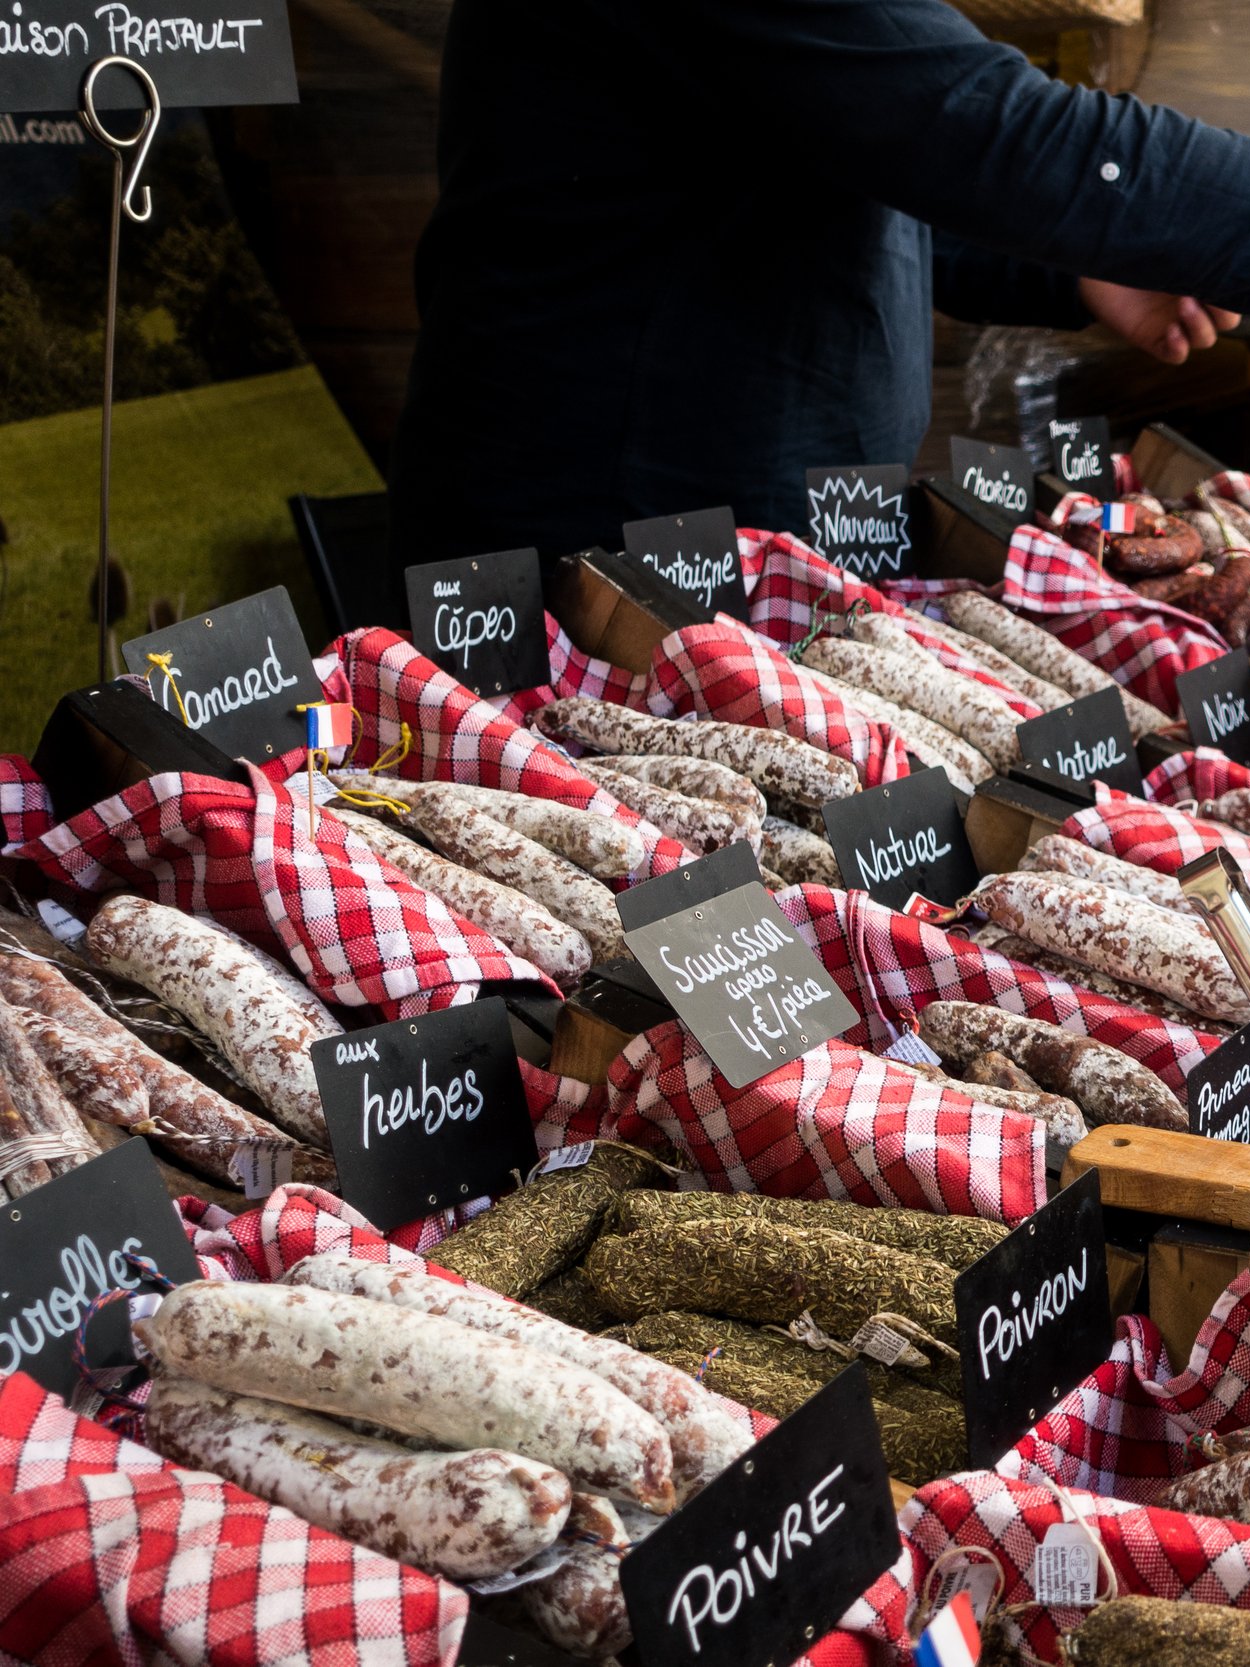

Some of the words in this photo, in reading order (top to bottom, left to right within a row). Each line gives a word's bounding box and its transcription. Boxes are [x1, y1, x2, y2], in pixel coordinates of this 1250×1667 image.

[95, 3, 262, 56] PRAJAULT
[824, 499, 899, 547] Nouveau
[433, 580, 461, 598] aux
[1202, 691, 1250, 743] Noix
[855, 826, 952, 890] Nature
[659, 917, 794, 994] Saucisson
[336, 1038, 380, 1066] aux
[363, 1058, 484, 1149] herbes
